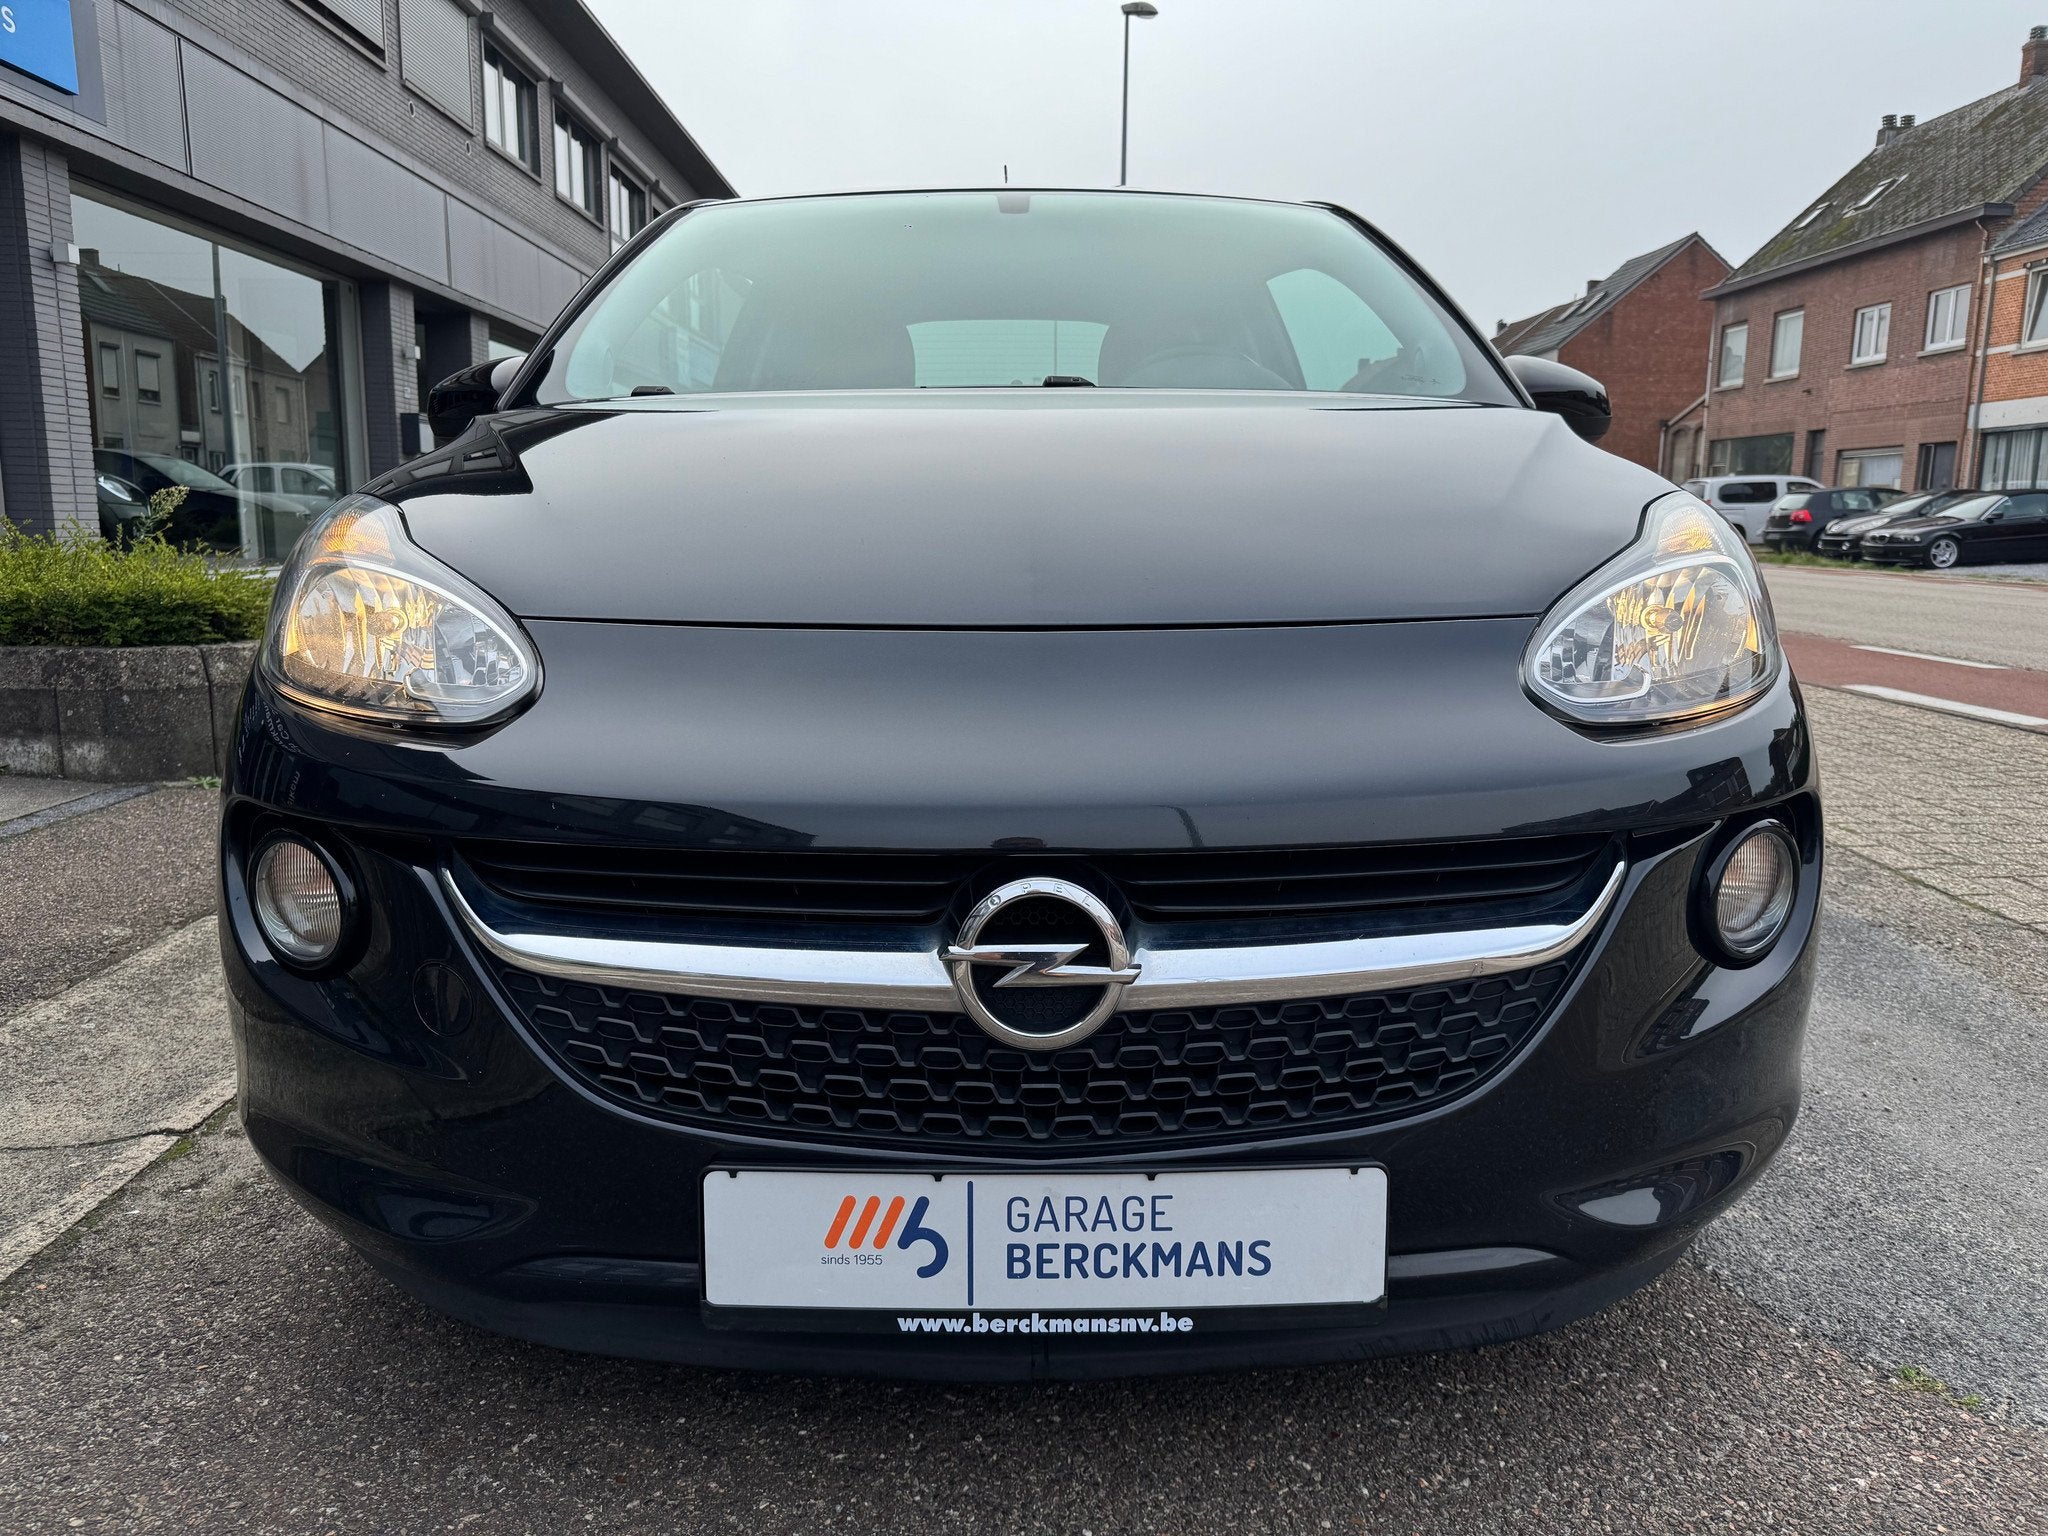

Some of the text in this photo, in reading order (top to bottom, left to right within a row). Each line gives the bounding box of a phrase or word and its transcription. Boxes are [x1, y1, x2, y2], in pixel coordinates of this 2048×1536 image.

[1006, 1194, 1174, 1233] GARAGE
[820, 1253, 883, 1266] sinds 1955
[1006, 1239, 1272, 1280] BERCKMANS
[897, 1311, 1194, 1335] www.berckmansnv.be
